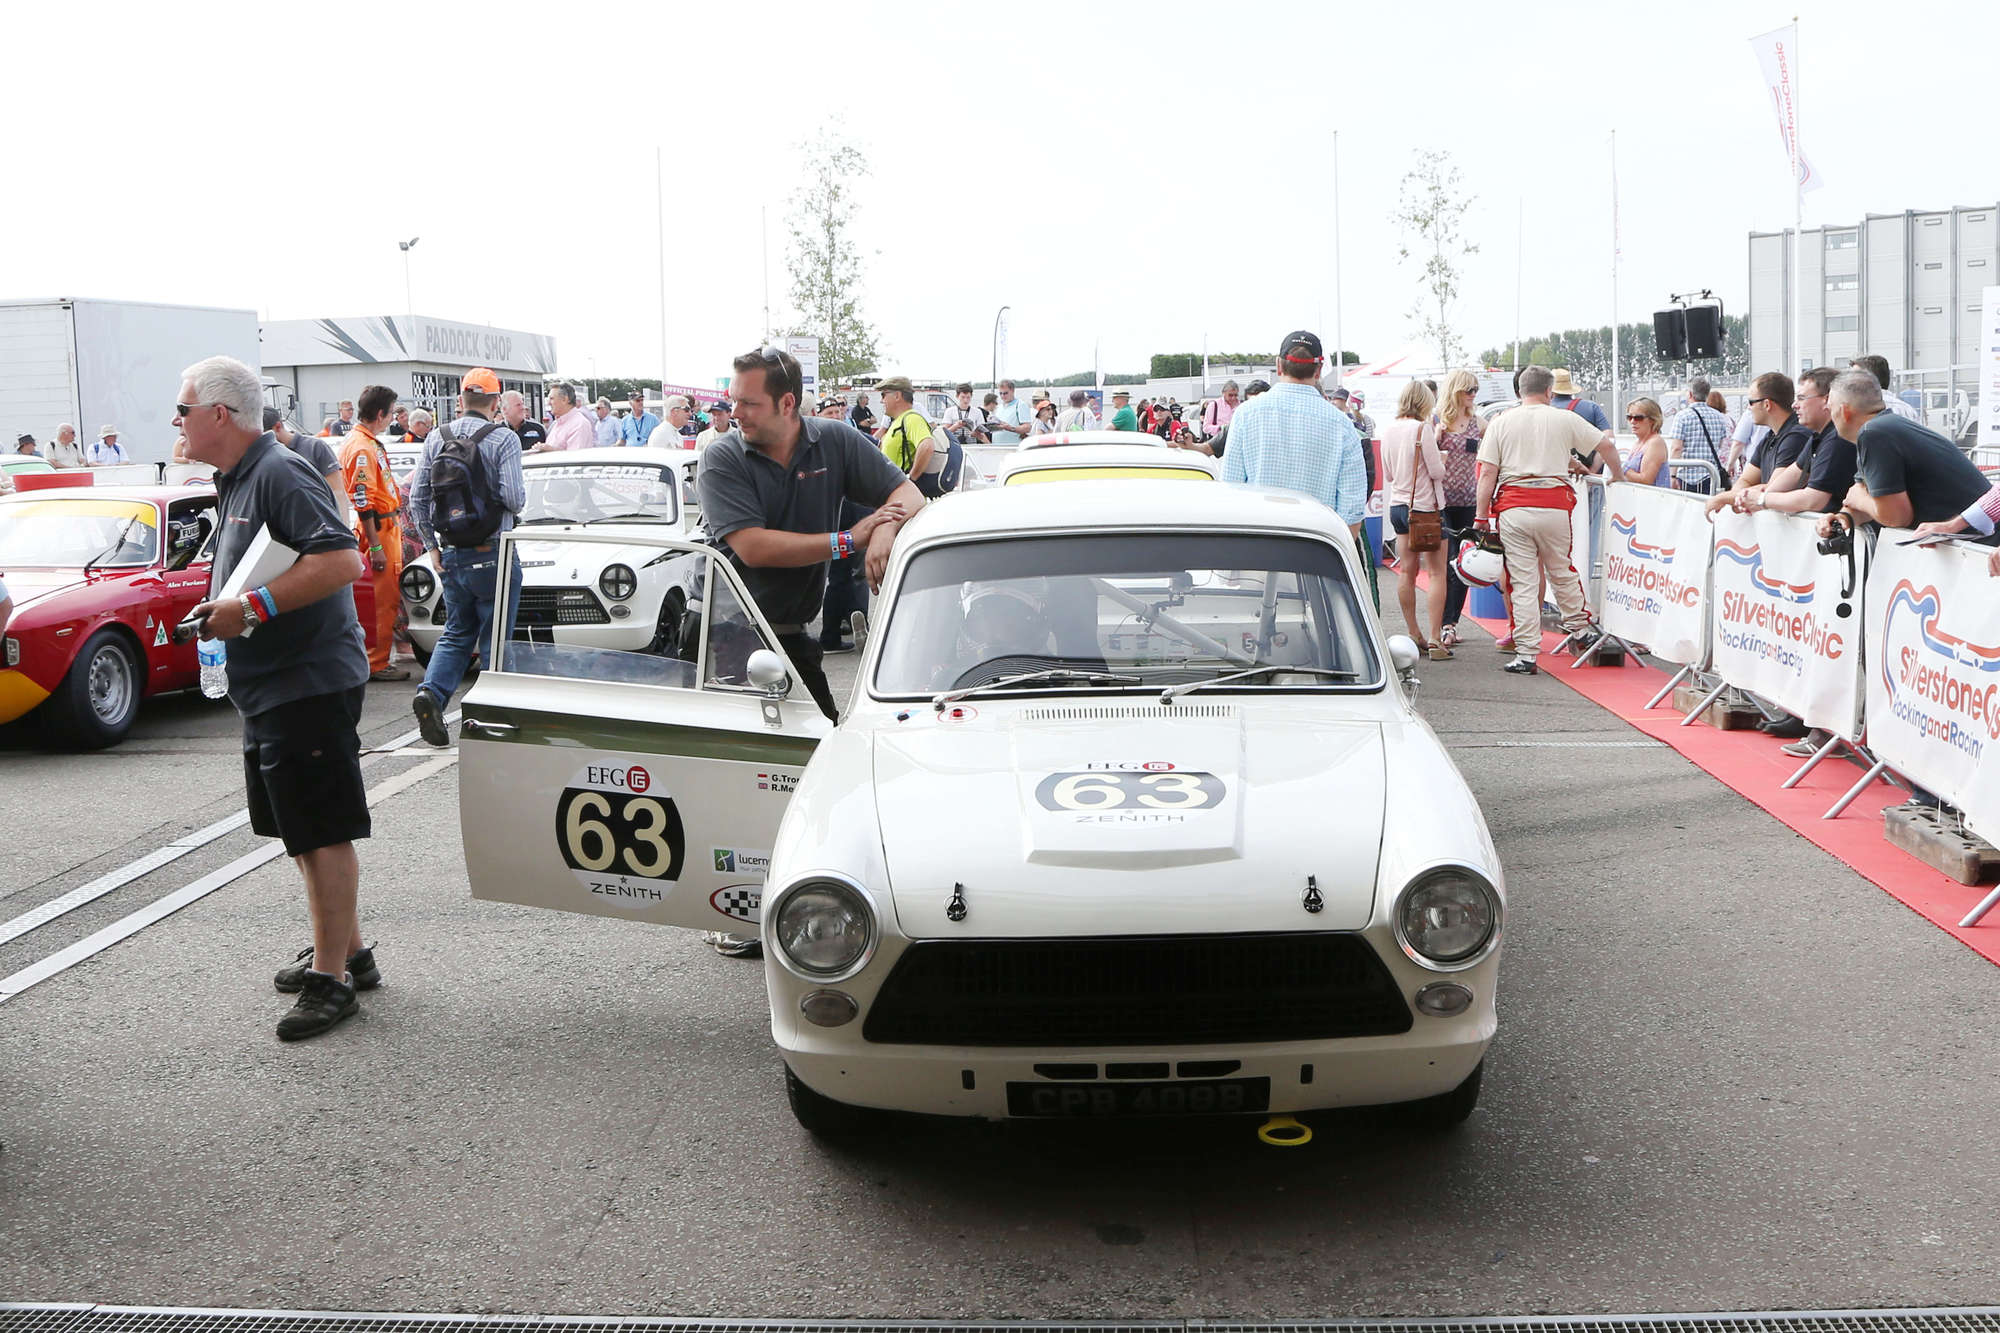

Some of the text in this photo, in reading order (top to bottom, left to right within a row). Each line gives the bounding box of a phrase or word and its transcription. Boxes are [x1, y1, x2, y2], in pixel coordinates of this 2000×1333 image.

[425, 325, 512, 361] PADDOCK SHOP
[587, 766, 624, 786] EFG
[1054, 774, 1208, 810] 63
[1076, 815, 1184, 823] ZENITH
[566, 792, 671, 877] 63
[590, 882, 662, 901] ZENITH
